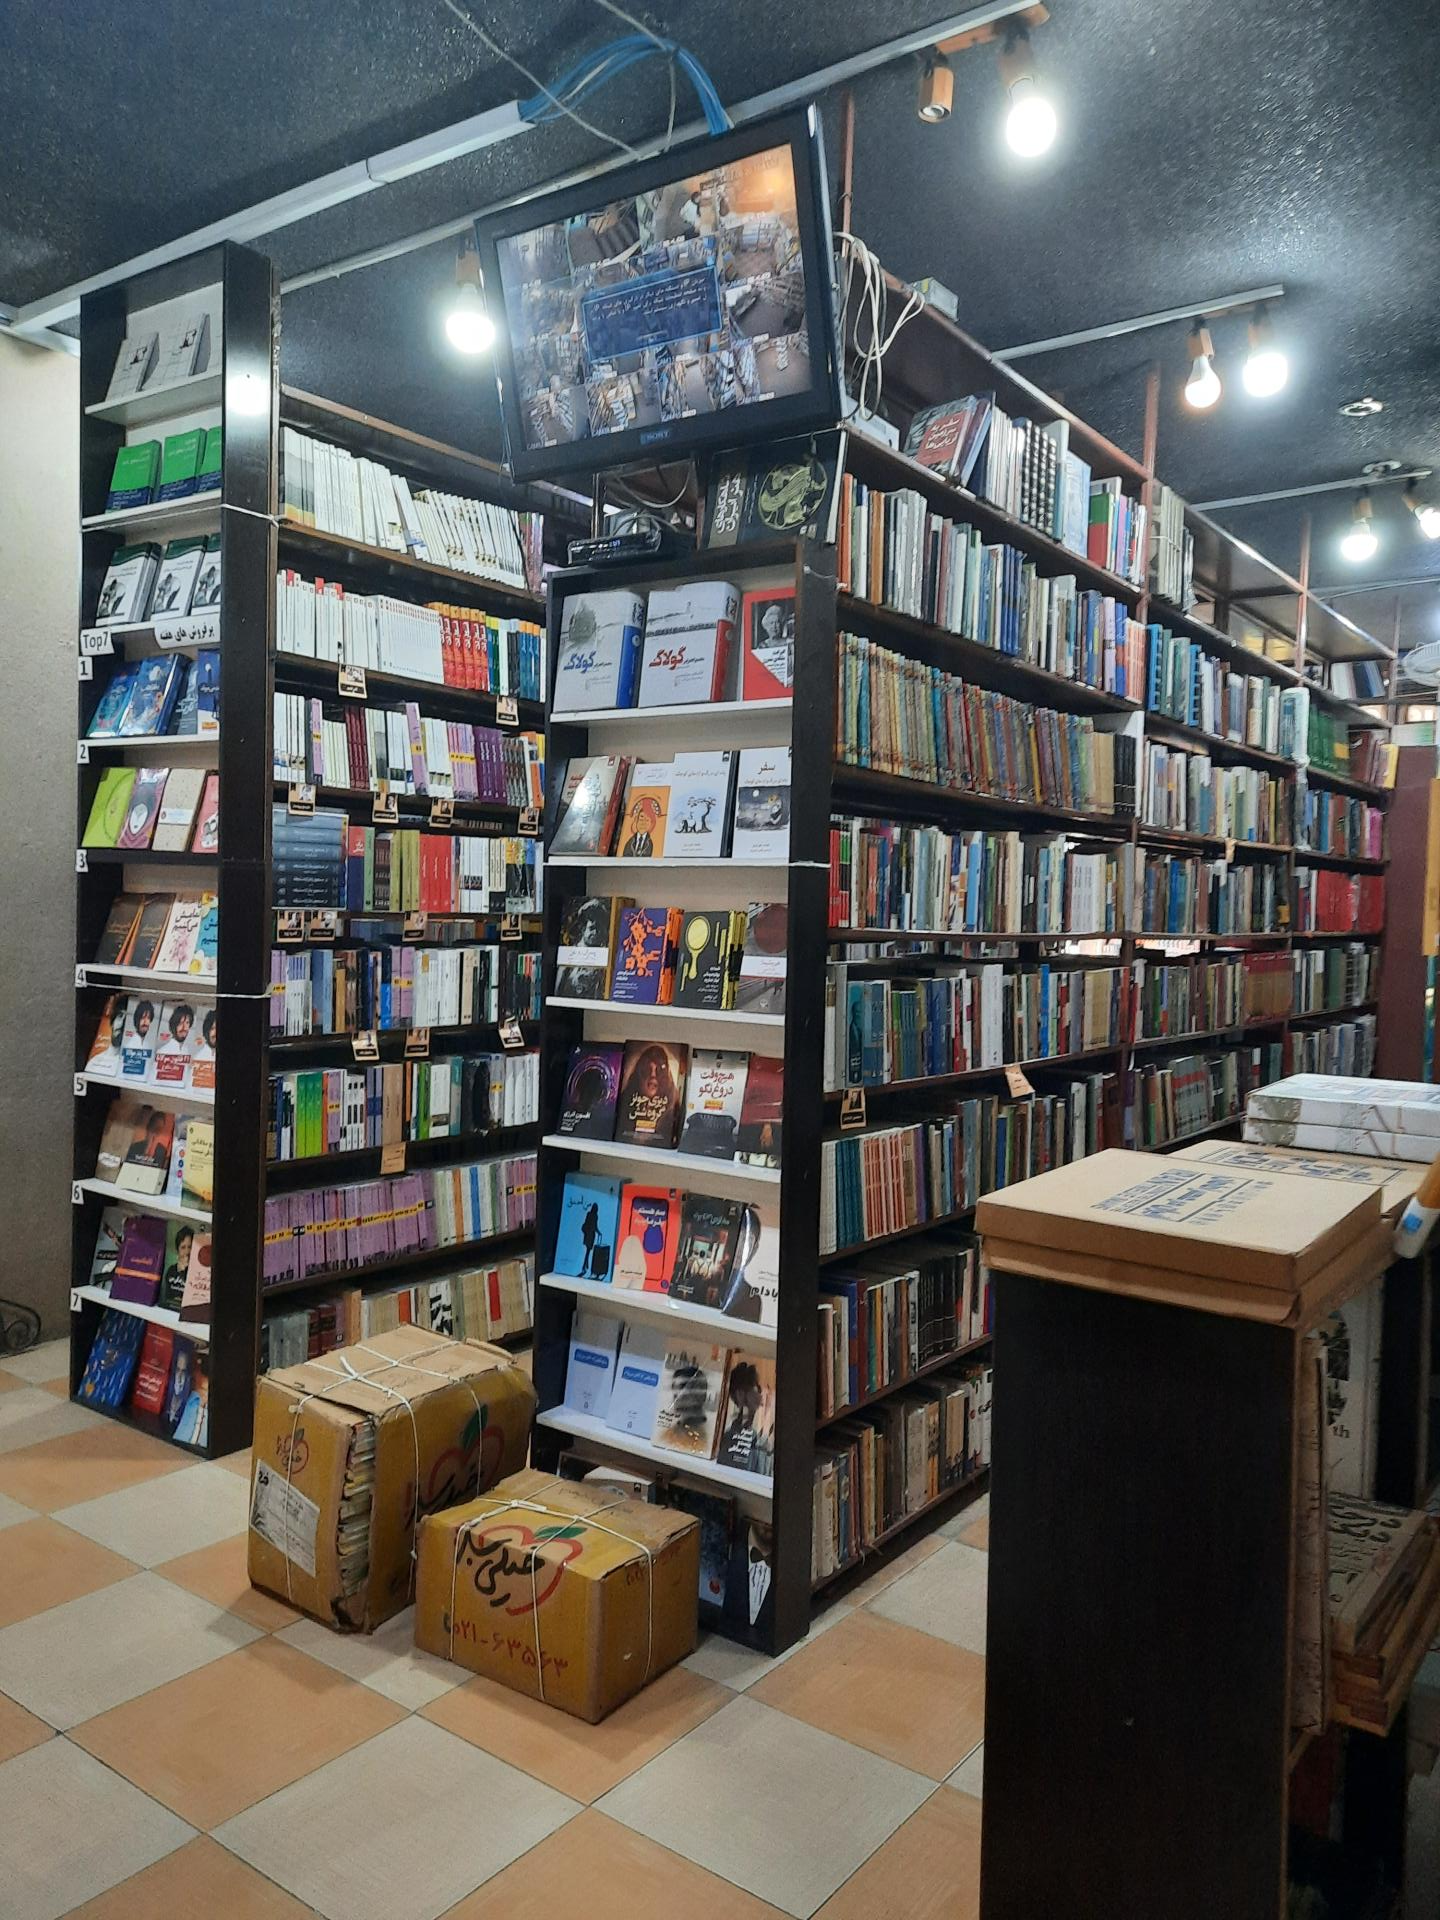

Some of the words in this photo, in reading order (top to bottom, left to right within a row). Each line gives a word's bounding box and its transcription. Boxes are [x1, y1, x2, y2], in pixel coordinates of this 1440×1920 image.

[83, 631, 109, 650] Top7
[80, 661, 88, 676] 1
[79, 744, 87, 759] 2
[757, 761, 776, 775] سفر
[79, 853, 85, 868] 3
[77, 968, 84, 981] 4
[75, 1077, 84, 1092] 5
[711, 1084, 734, 1099] دروغ
[73, 1188, 80, 1201] 6
[73, 1293, 79, 1307] 7
